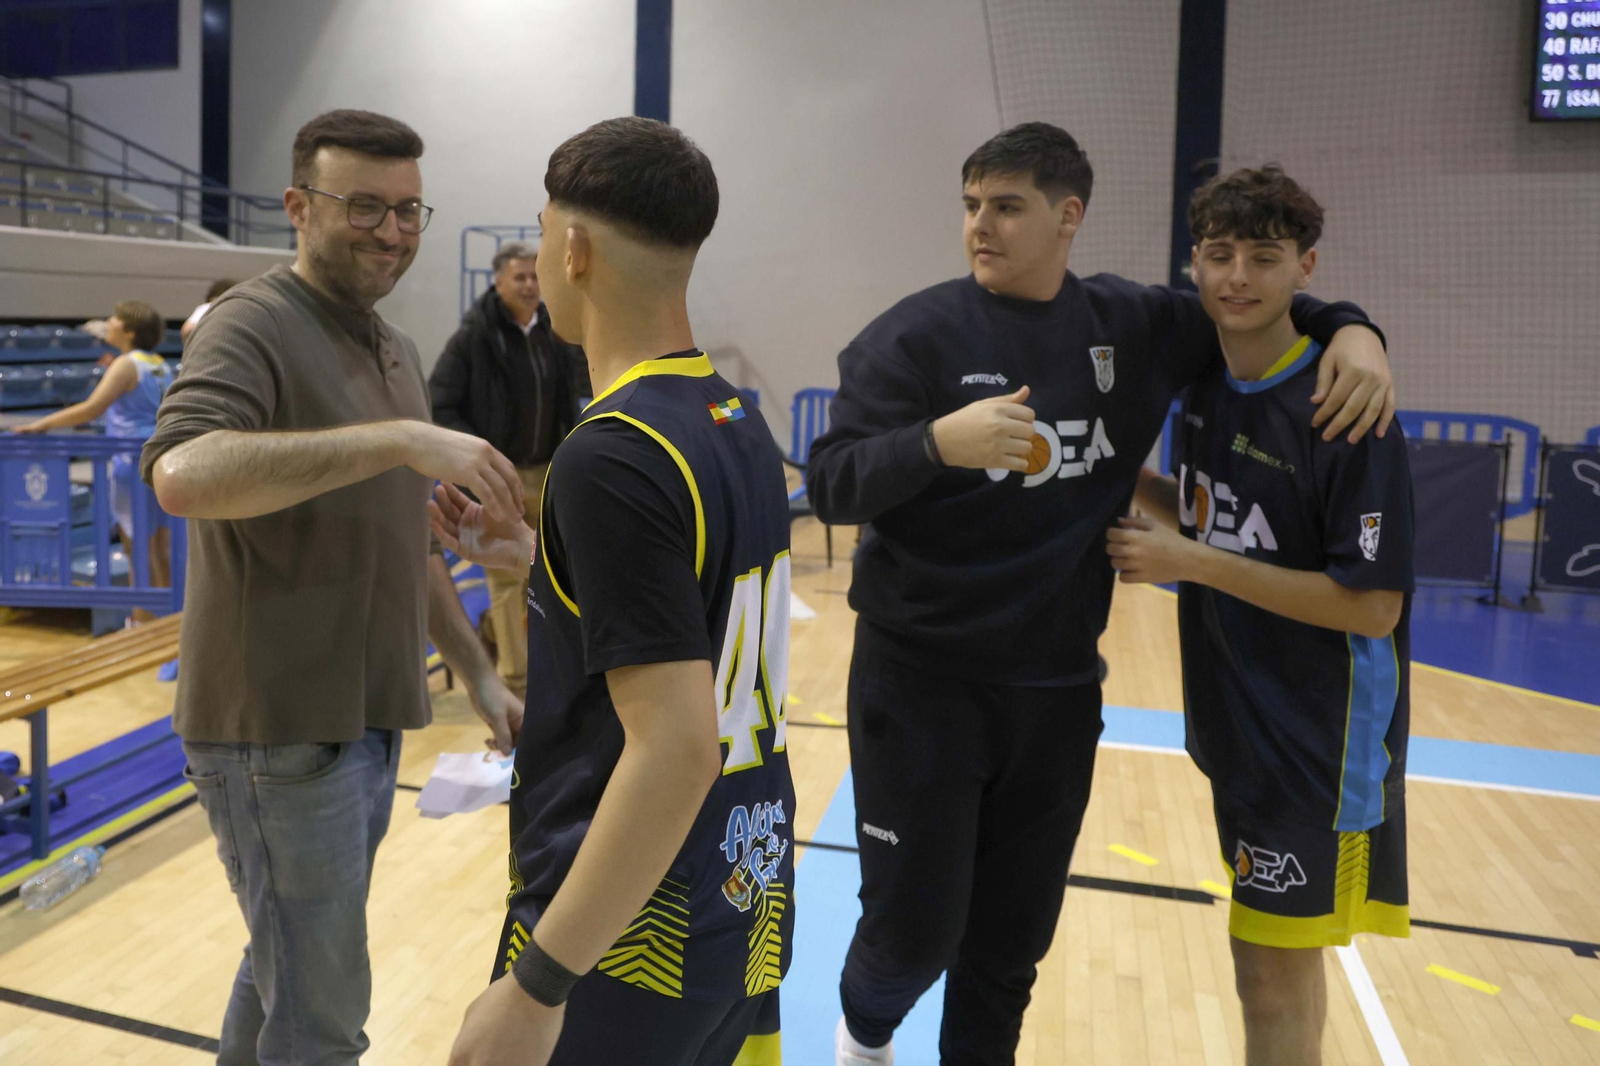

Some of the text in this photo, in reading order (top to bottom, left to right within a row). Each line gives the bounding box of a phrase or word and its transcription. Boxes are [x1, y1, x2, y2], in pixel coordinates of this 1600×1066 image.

[1545, 11, 1568, 30] 30
[1543, 37, 1566, 56] 40
[1542, 63, 1565, 82] 50
[1541, 89, 1561, 108] 77
[985, 417, 1115, 487] DEA
